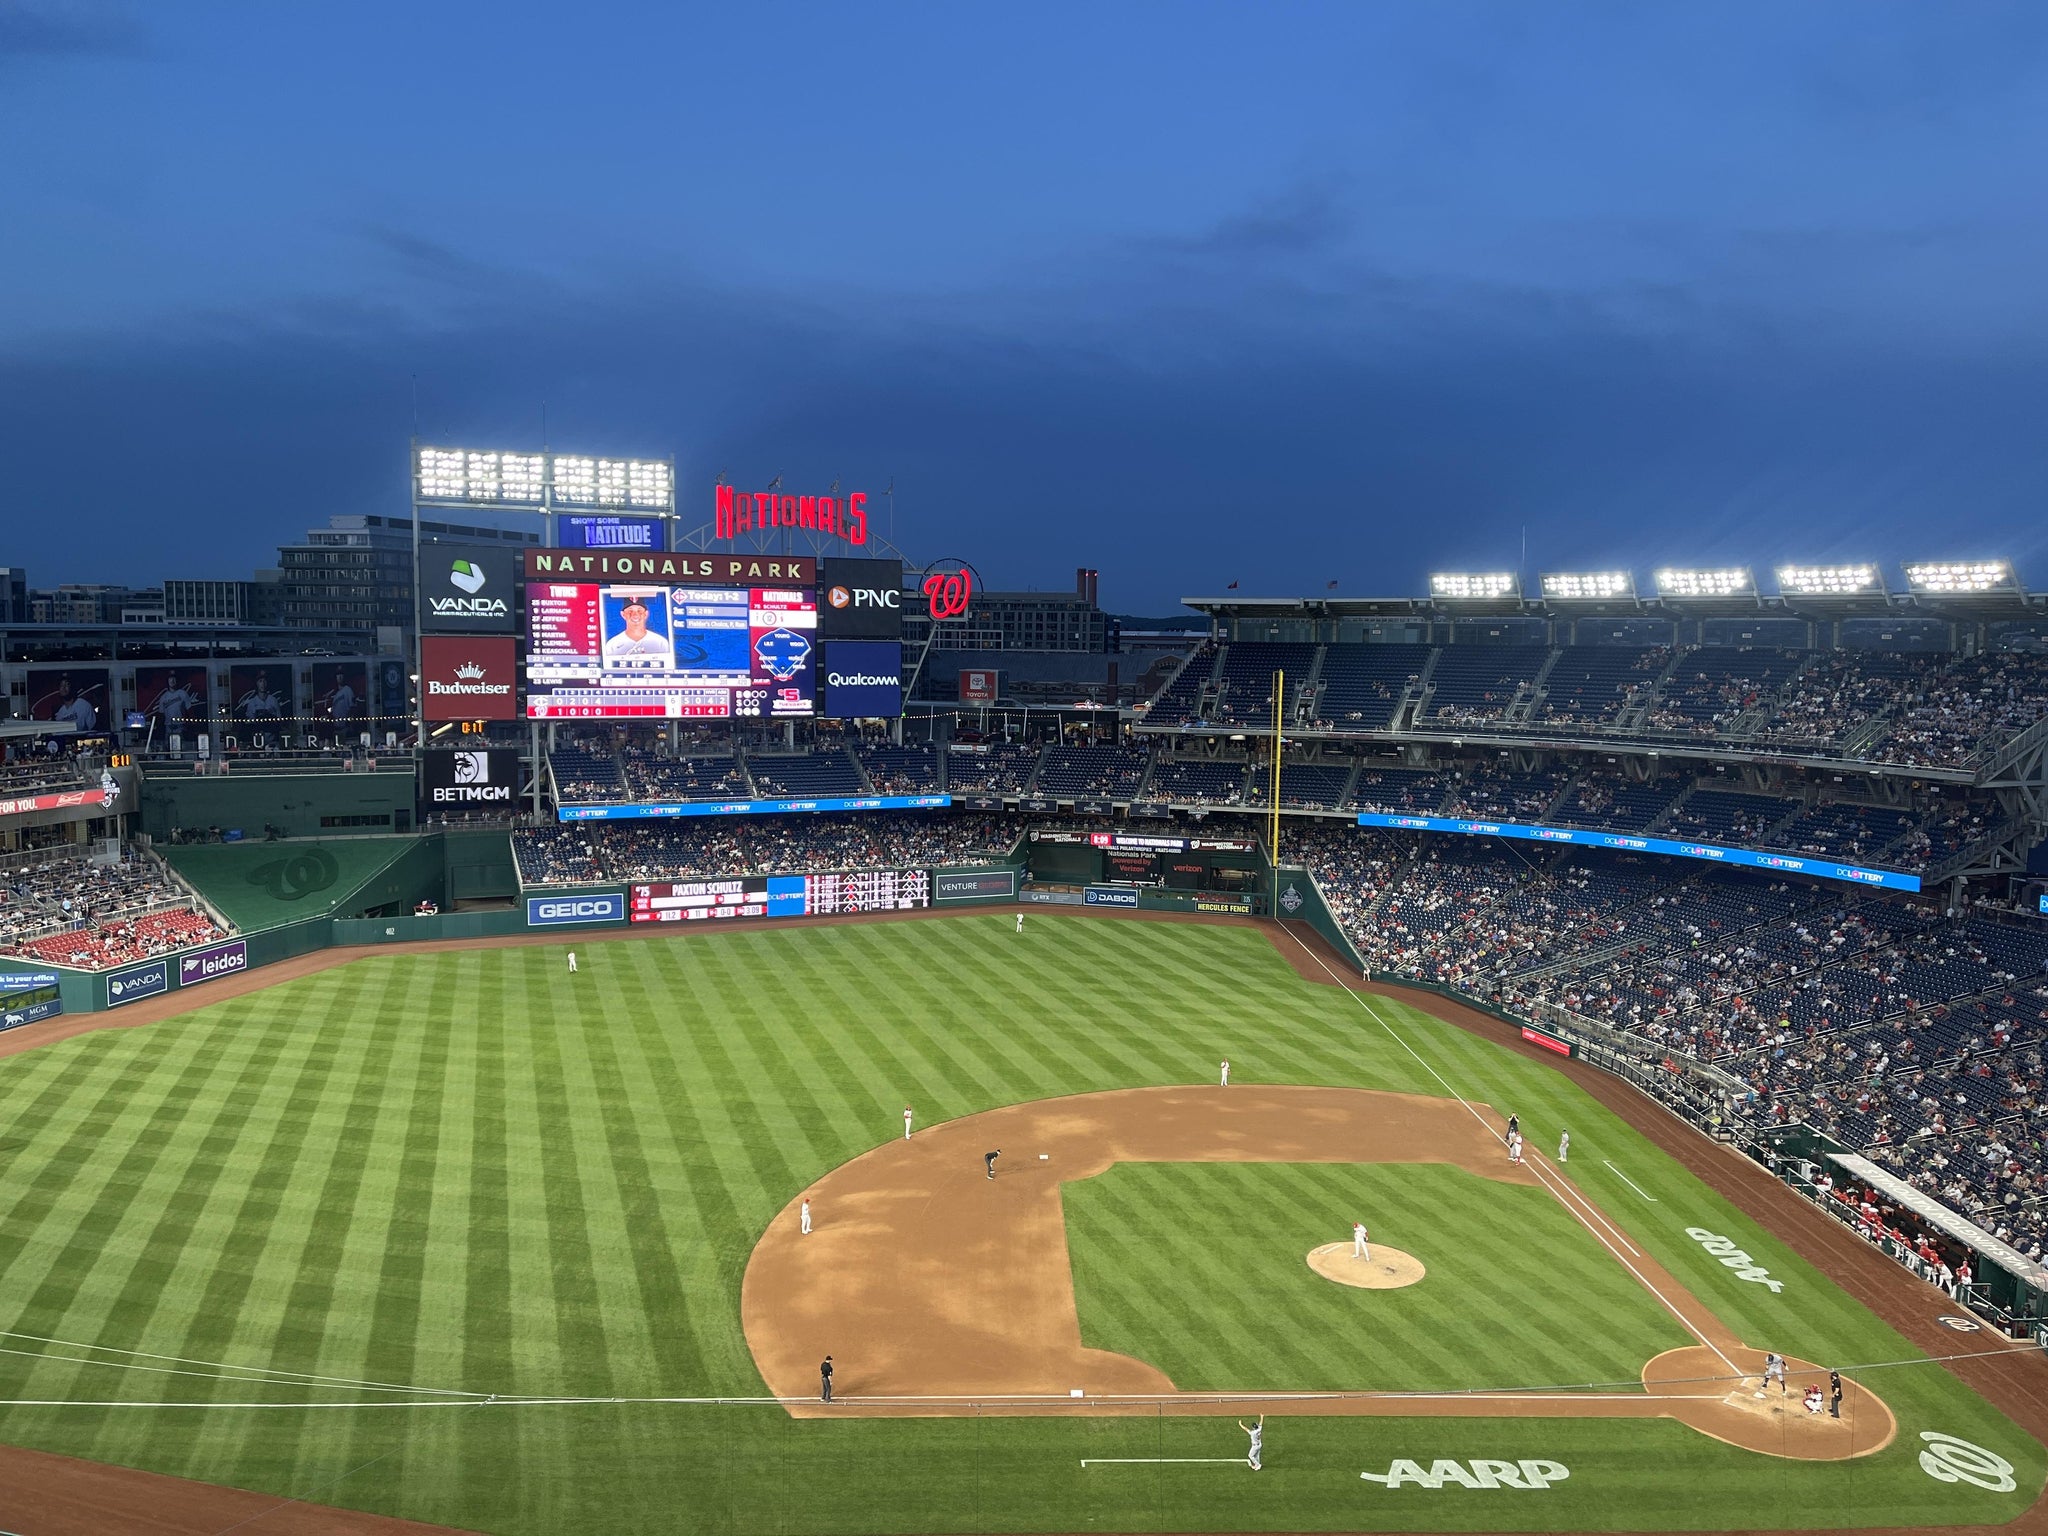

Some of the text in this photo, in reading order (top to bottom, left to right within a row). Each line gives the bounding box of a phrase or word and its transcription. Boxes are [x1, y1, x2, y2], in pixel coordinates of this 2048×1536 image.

[570, 516, 620, 525] SHOW SOME
[716, 484, 867, 545] NATIONALS
[585, 524, 651, 546] NATITUDE
[536, 554, 801, 579] NATIONALS PARK
[549, 585, 578, 598] TWINS
[688, 591, 739, 602] Today: 1-2
[763, 591, 803, 602] NATIONALS
[852, 588, 900, 608] PNC
[428, 597, 508, 612] VANDA
[428, 680, 511, 695] Budweiser
[828, 672, 899, 688] Qualcomm
[433, 786, 510, 802] BETMGM
[17, 798, 38, 811] YOU.
[1115, 837, 1138, 846] WELCOME
[1107, 850, 1140, 858] Nationals
[1172, 864, 1203, 873] verizon
[672, 880, 743, 897] PAXTON SCHULTZ
[941, 881, 977, 891] VENTURE
[1098, 894, 1136, 903] DABOS
[538, 900, 613, 919] GEICO
[1197, 903, 1250, 913] HERCULES FENCE
[202, 951, 244, 975] leidos
[123, 972, 163, 989] VANDA
[29, 1005, 48, 1015] MGM
[1684, 1227, 1785, 1293] AARP
[1360, 1459, 1570, 1489] AARP
